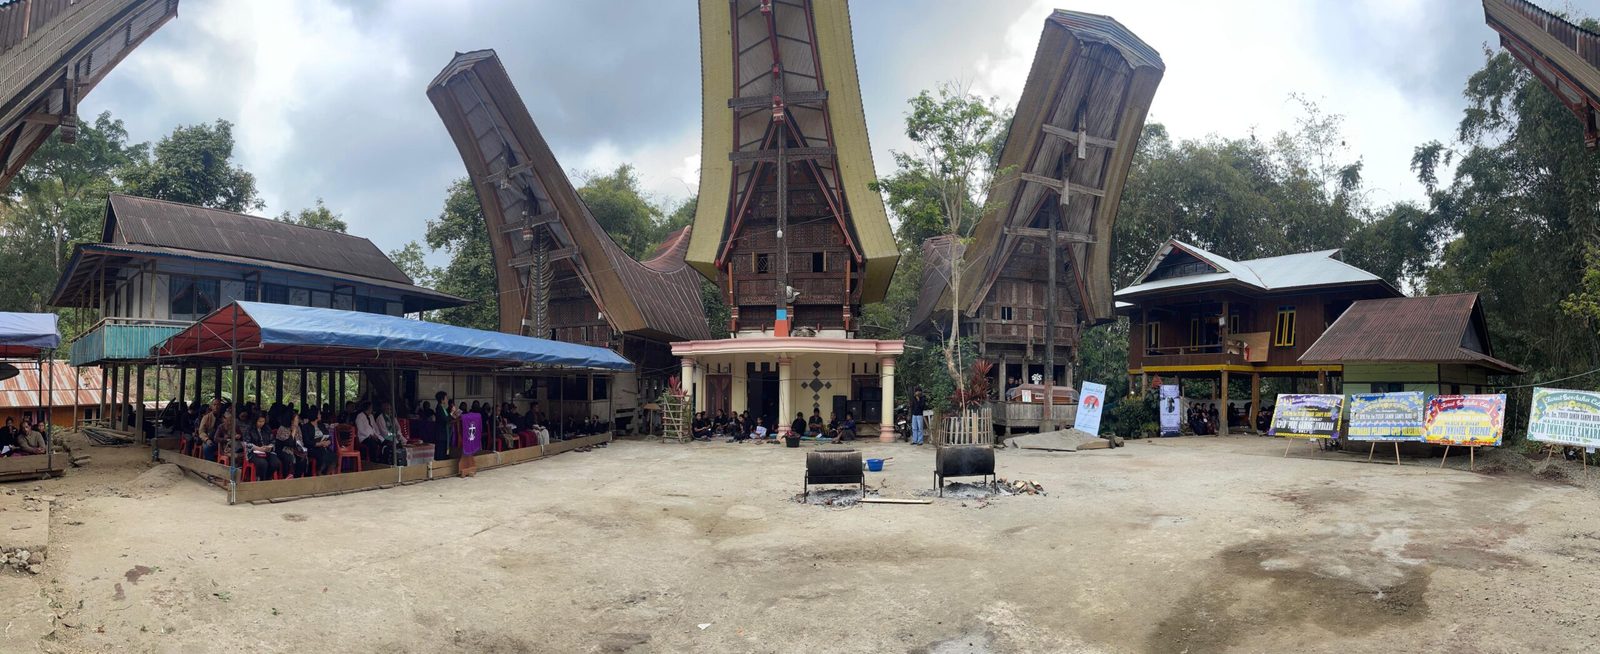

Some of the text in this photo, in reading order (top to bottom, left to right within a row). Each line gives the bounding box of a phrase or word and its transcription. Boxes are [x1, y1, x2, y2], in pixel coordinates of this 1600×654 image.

[1562, 393, 1590, 402] Berduka
[1531, 422, 1600, 440] GPIB IMMANUEL SAMAR
